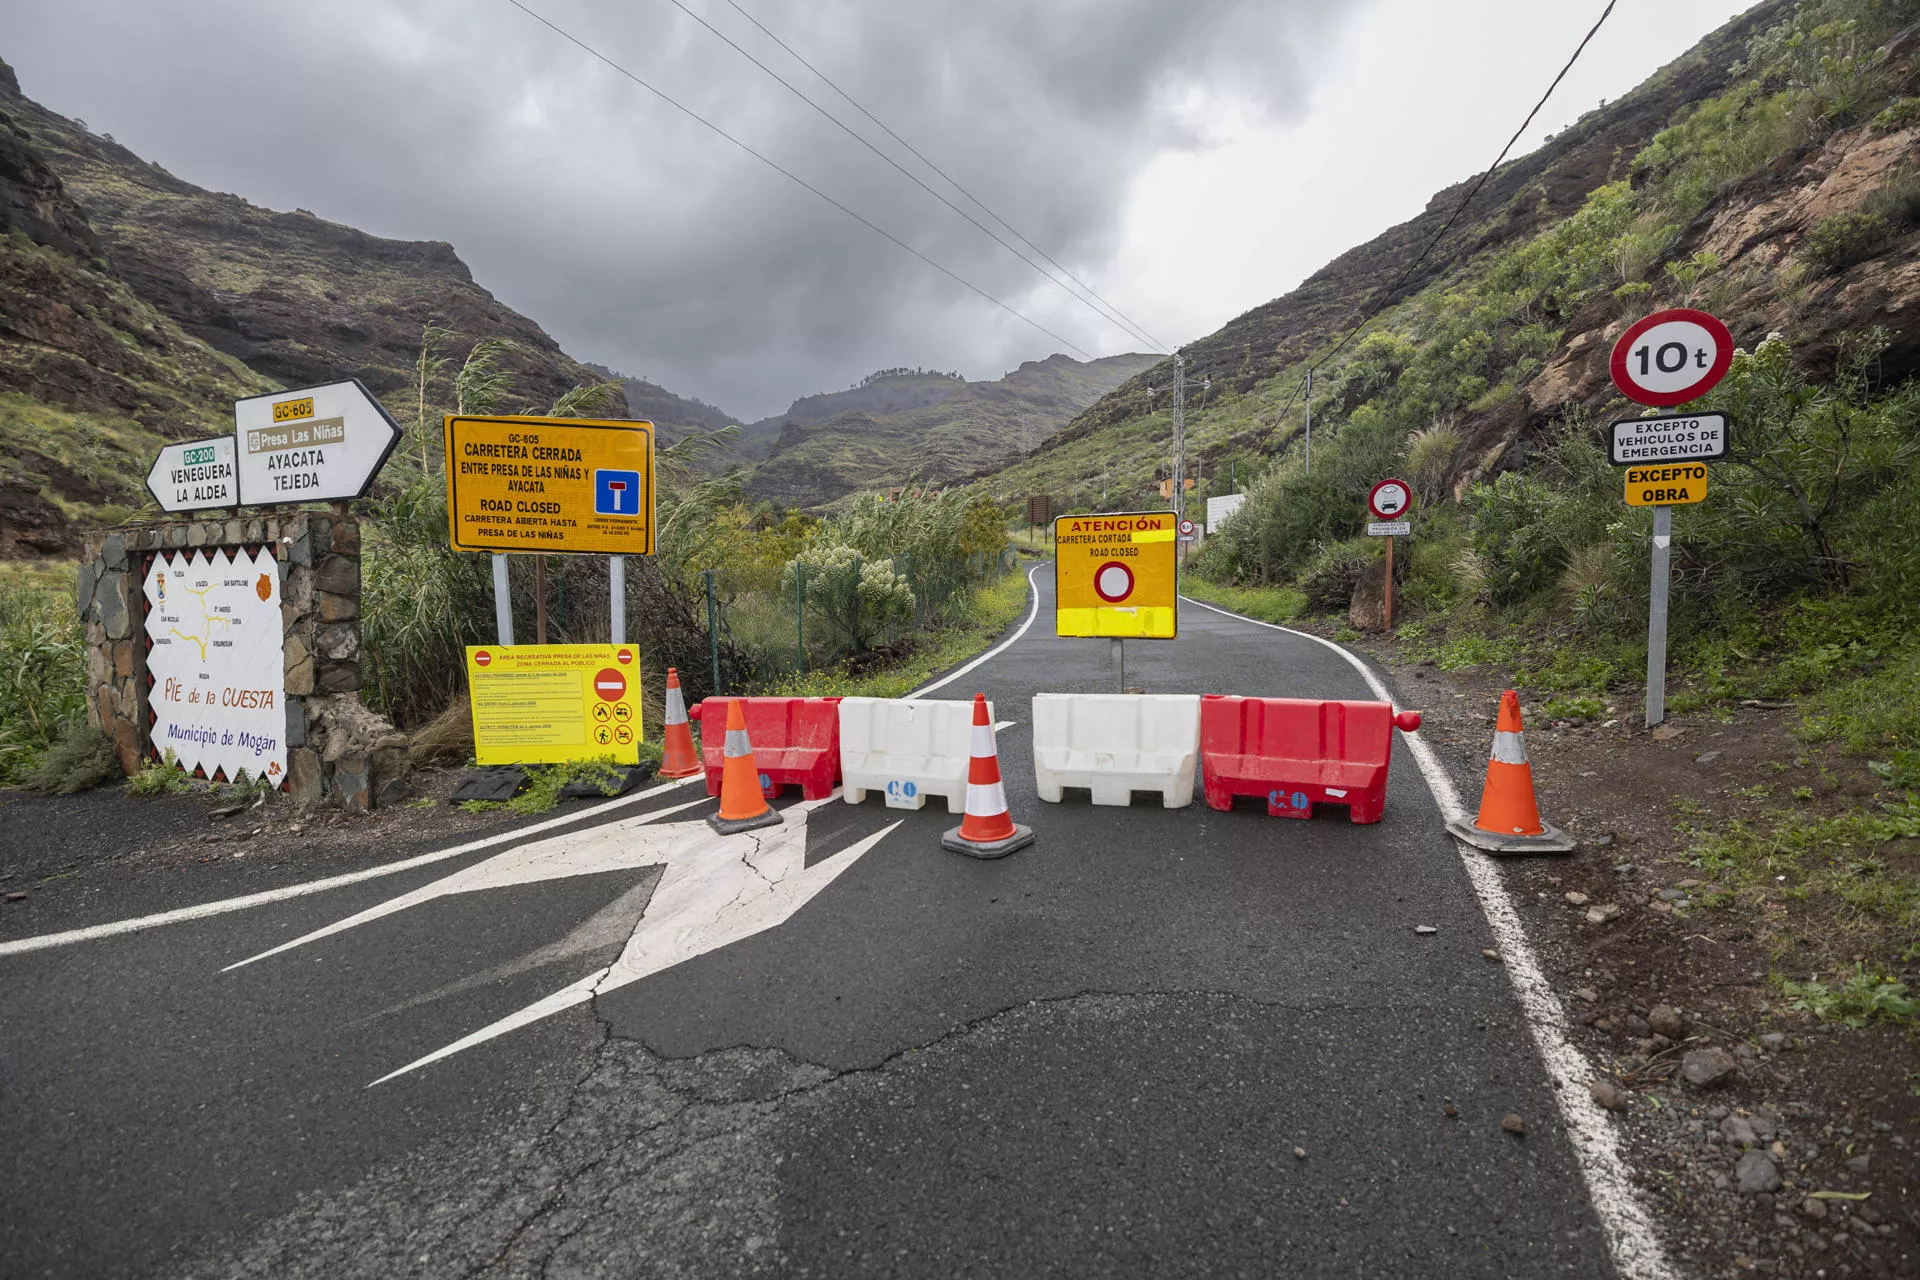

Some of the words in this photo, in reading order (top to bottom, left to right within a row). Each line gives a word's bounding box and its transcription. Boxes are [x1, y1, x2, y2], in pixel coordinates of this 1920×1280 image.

[1634, 341, 1688, 376] 10
[1694, 348, 1708, 369] t
[275, 401, 312, 419] GC-605
[261, 433, 288, 447] Presa
[292, 429, 309, 443] Las
[313, 424, 343, 440] Niñas
[1636, 420, 1700, 434] EXCEPTO
[508, 433, 539, 444] GC-605
[1618, 432, 1696, 447] VEHICULOS
[1701, 430, 1719, 441] DE
[184, 448, 214, 464] GC-200
[464, 443, 529, 459] CARRETERA
[532, 446, 582, 462] CERRADA
[1622, 443, 1714, 458] EMERGENCIA
[268, 449, 325, 471] AYACATA
[171, 463, 232, 484] VENEGUERA
[461, 461, 488, 475] ENTRE
[491, 463, 519, 477] PRESA
[521, 465, 533, 477] DE
[535, 465, 552, 478] LAS
[554, 464, 581, 480] NIÑAS
[583, 468, 590, 480] Y
[1628, 466, 1706, 483] EXCEPTO
[273, 472, 319, 490] TEJEDA
[508, 480, 545, 493] AYACATA
[176, 488, 188, 503] LA
[194, 484, 227, 501] ALDEA
[1642, 487, 1689, 502] OBRA
[480, 499, 513, 512] ROAD
[516, 501, 561, 514] CLOSED
[464, 514, 512, 525] CARRETERA
[515, 517, 548, 526] ABIERTA
[550, 518, 577, 527] HASTA
[1071, 516, 1162, 532] ATENCIÓN
[478, 528, 505, 537] PRESA
[507, 529, 518, 538] DE
[520, 530, 536, 539] LAS
[538, 530, 564, 540] NIÑAS
[1057, 534, 1097, 545] CARRETERA
[1098, 535, 1132, 544] CORTADA
[1089, 548, 1110, 557] ROAD
[1110, 547, 1139, 557] CLOSED
[188, 687, 200, 704] de
[206, 690, 216, 705] la
[222, 687, 274, 710] CUESTA
[167, 723, 217, 749] Municipio
[221, 728, 234, 746] de
[238, 731, 276, 756] Mogán
